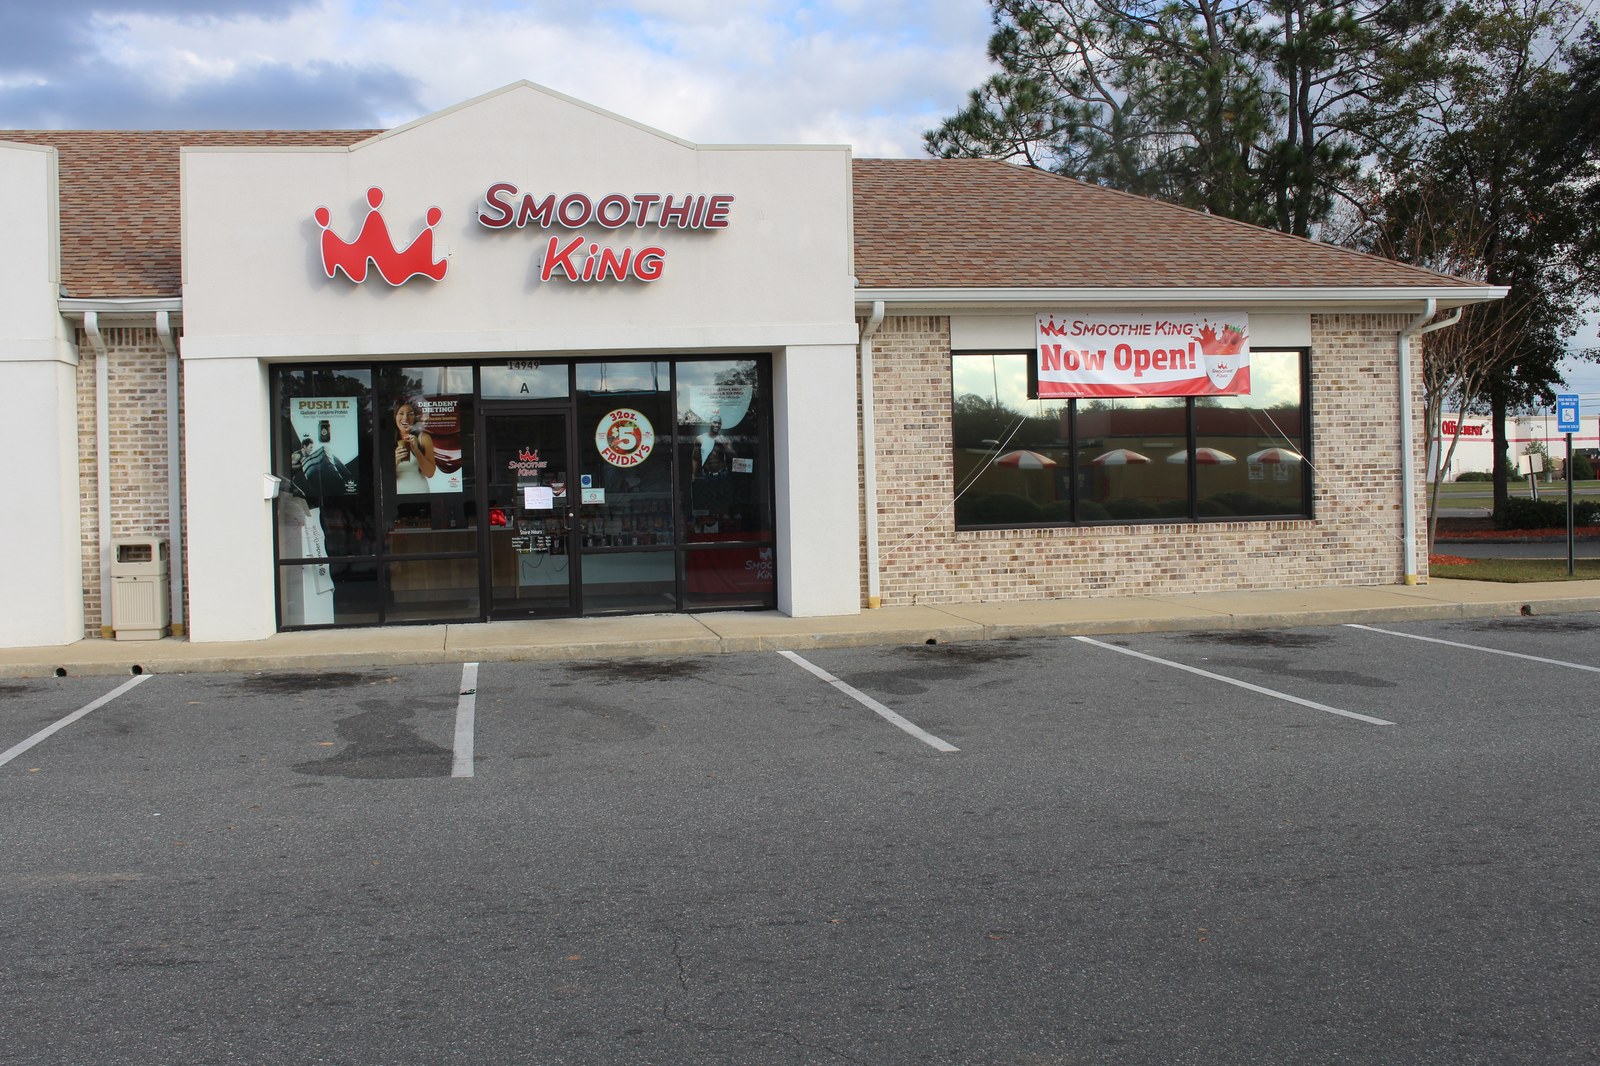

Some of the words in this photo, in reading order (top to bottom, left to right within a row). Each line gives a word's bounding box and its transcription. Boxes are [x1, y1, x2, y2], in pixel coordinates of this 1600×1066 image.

[478, 181, 735, 229] SMOOTHIE
[1070, 320, 1151, 337] SMOOTHIE
[1040, 343, 1107, 372] Now
[1113, 342, 1197, 377] Open!
[508, 361, 540, 371] 14949
[520, 382, 530, 394] A
[298, 400, 333, 410] PUSH
[336, 400, 350, 409] IT.
[418, 400, 458, 408] DECADENT
[610, 410, 637, 421] 32oz.
[601, 444, 651, 466] FRIDAYS
